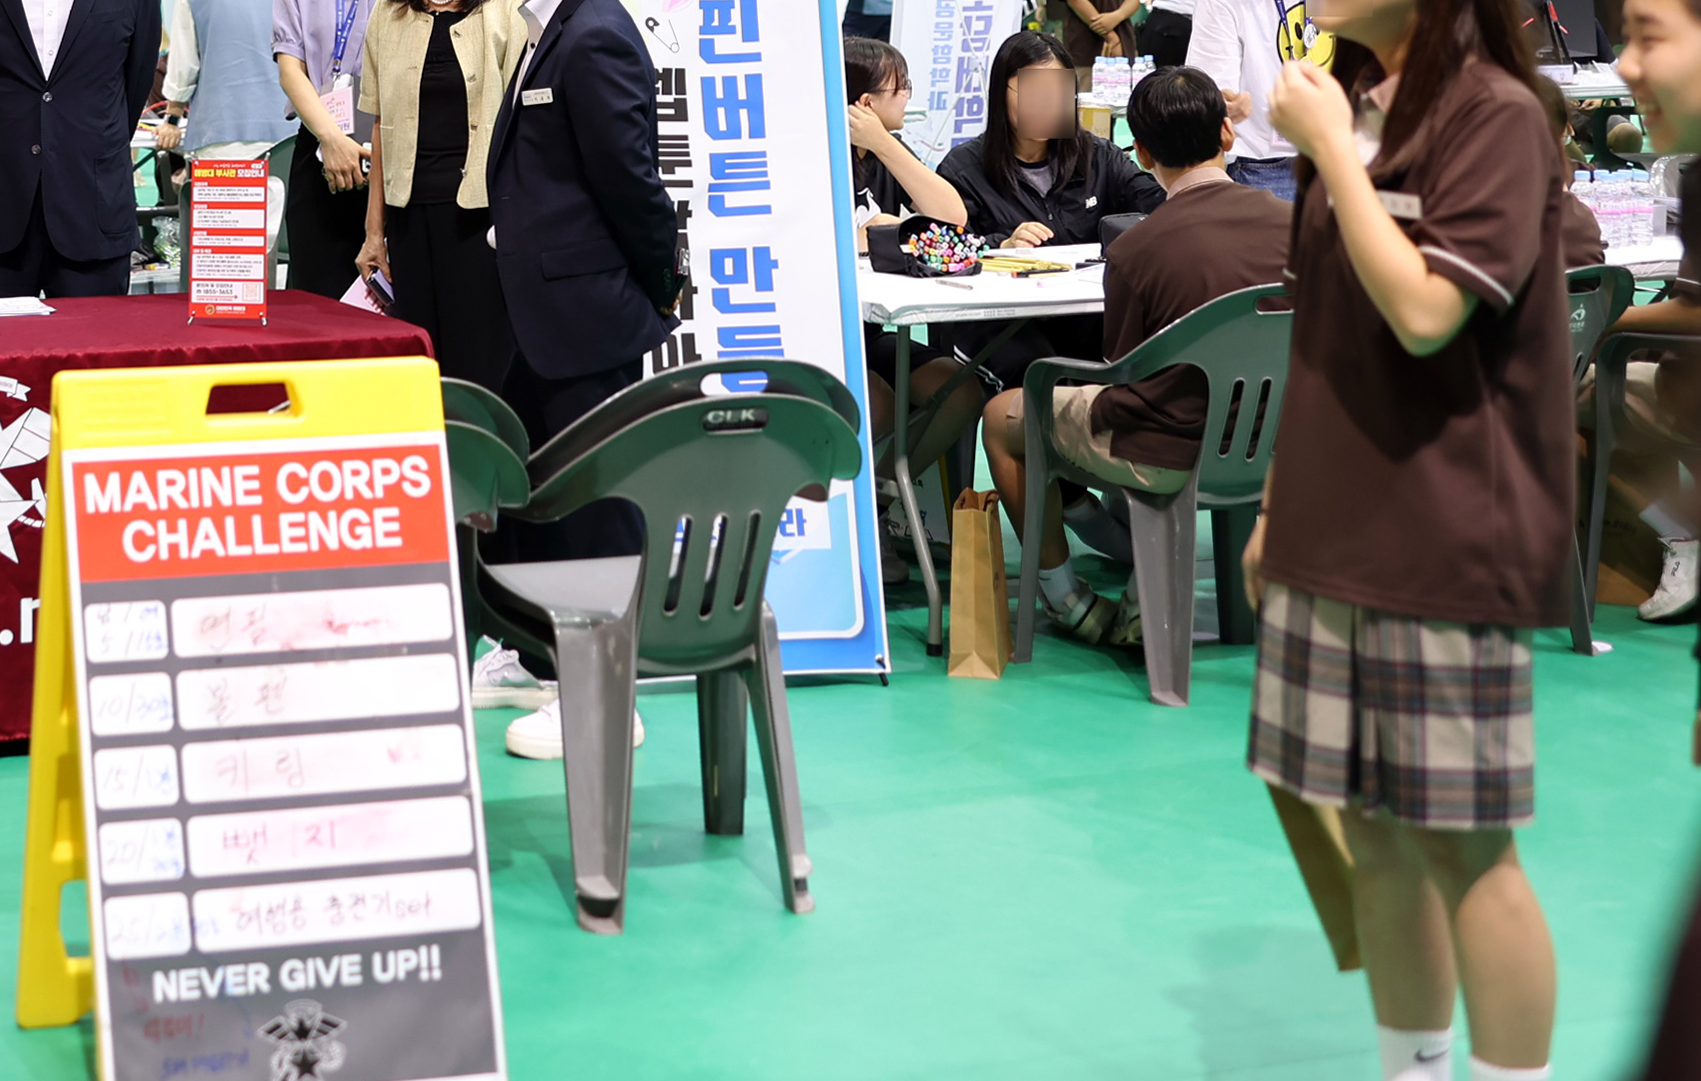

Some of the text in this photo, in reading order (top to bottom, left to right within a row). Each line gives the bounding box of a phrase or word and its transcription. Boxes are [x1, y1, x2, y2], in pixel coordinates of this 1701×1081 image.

[707, 409, 755, 424] CLK
[83, 455, 432, 514] MARINE CORPS
[122, 506, 403, 563] CHALLENGE
[153, 944, 442, 1004] NEVER GIVE UP!!
